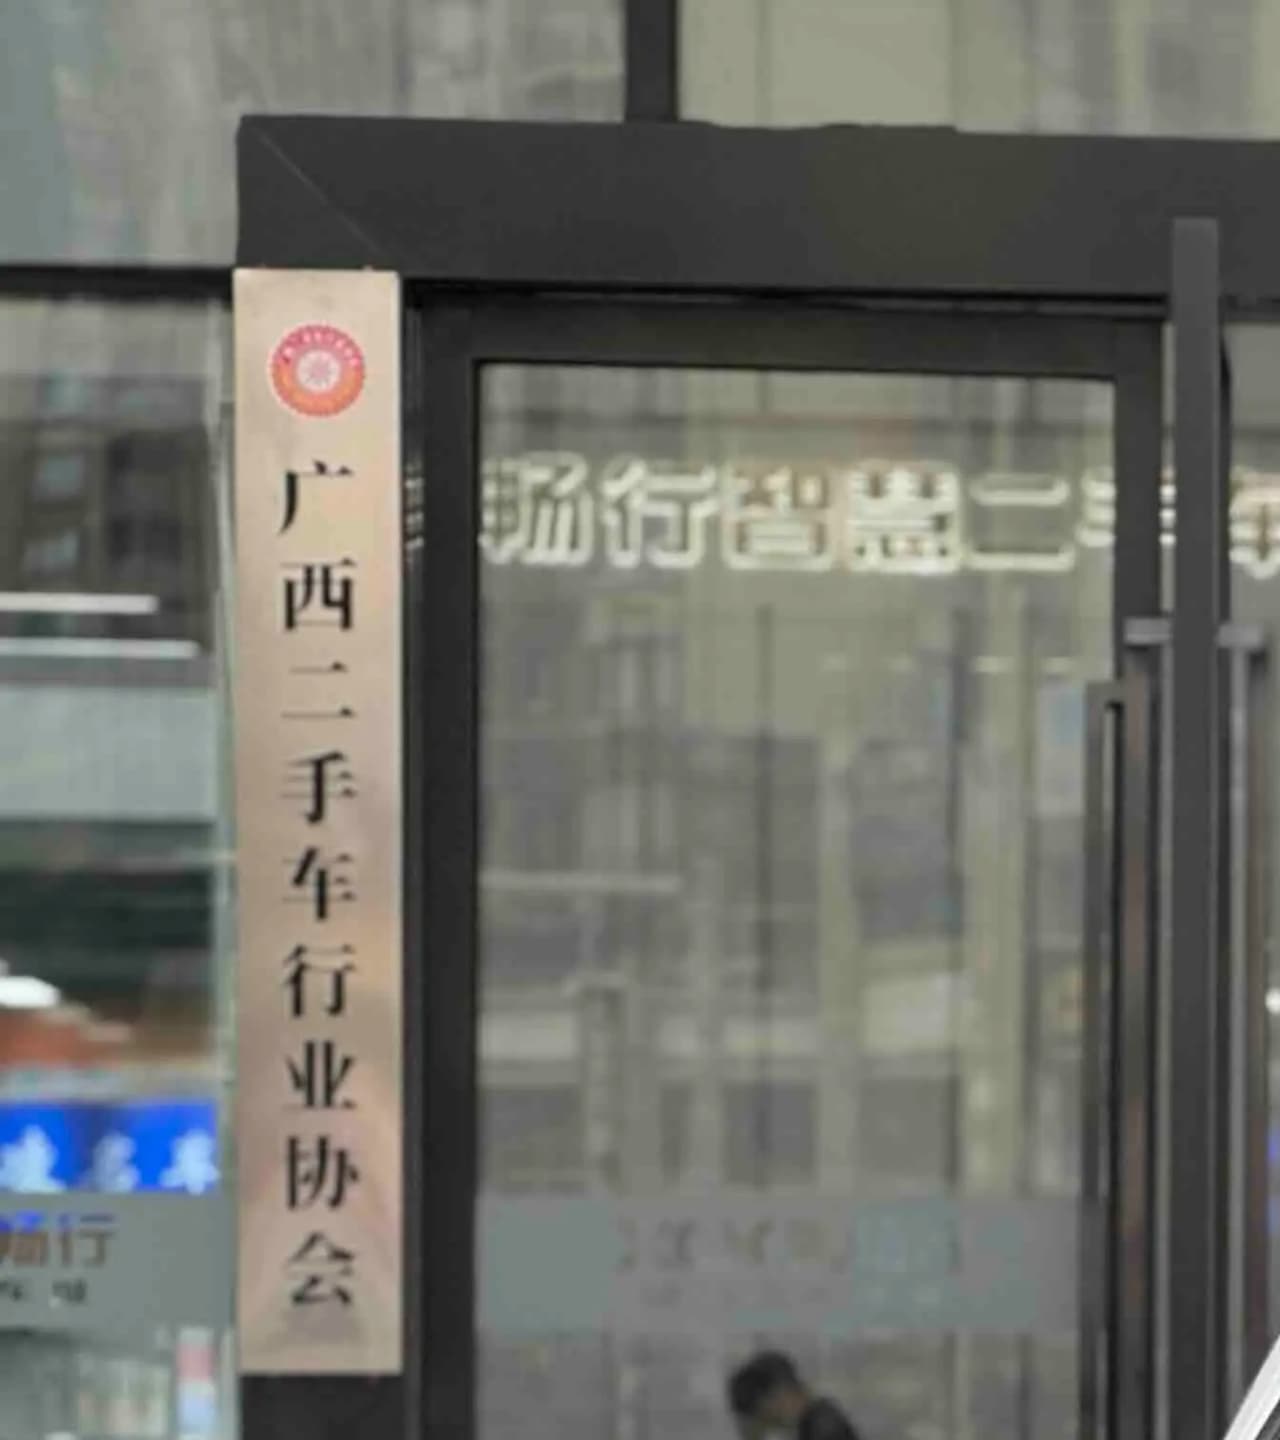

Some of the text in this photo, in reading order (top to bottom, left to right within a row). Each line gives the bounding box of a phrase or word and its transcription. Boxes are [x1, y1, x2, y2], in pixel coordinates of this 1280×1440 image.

[279, 460, 361, 1309] 广西二手车行业协会
